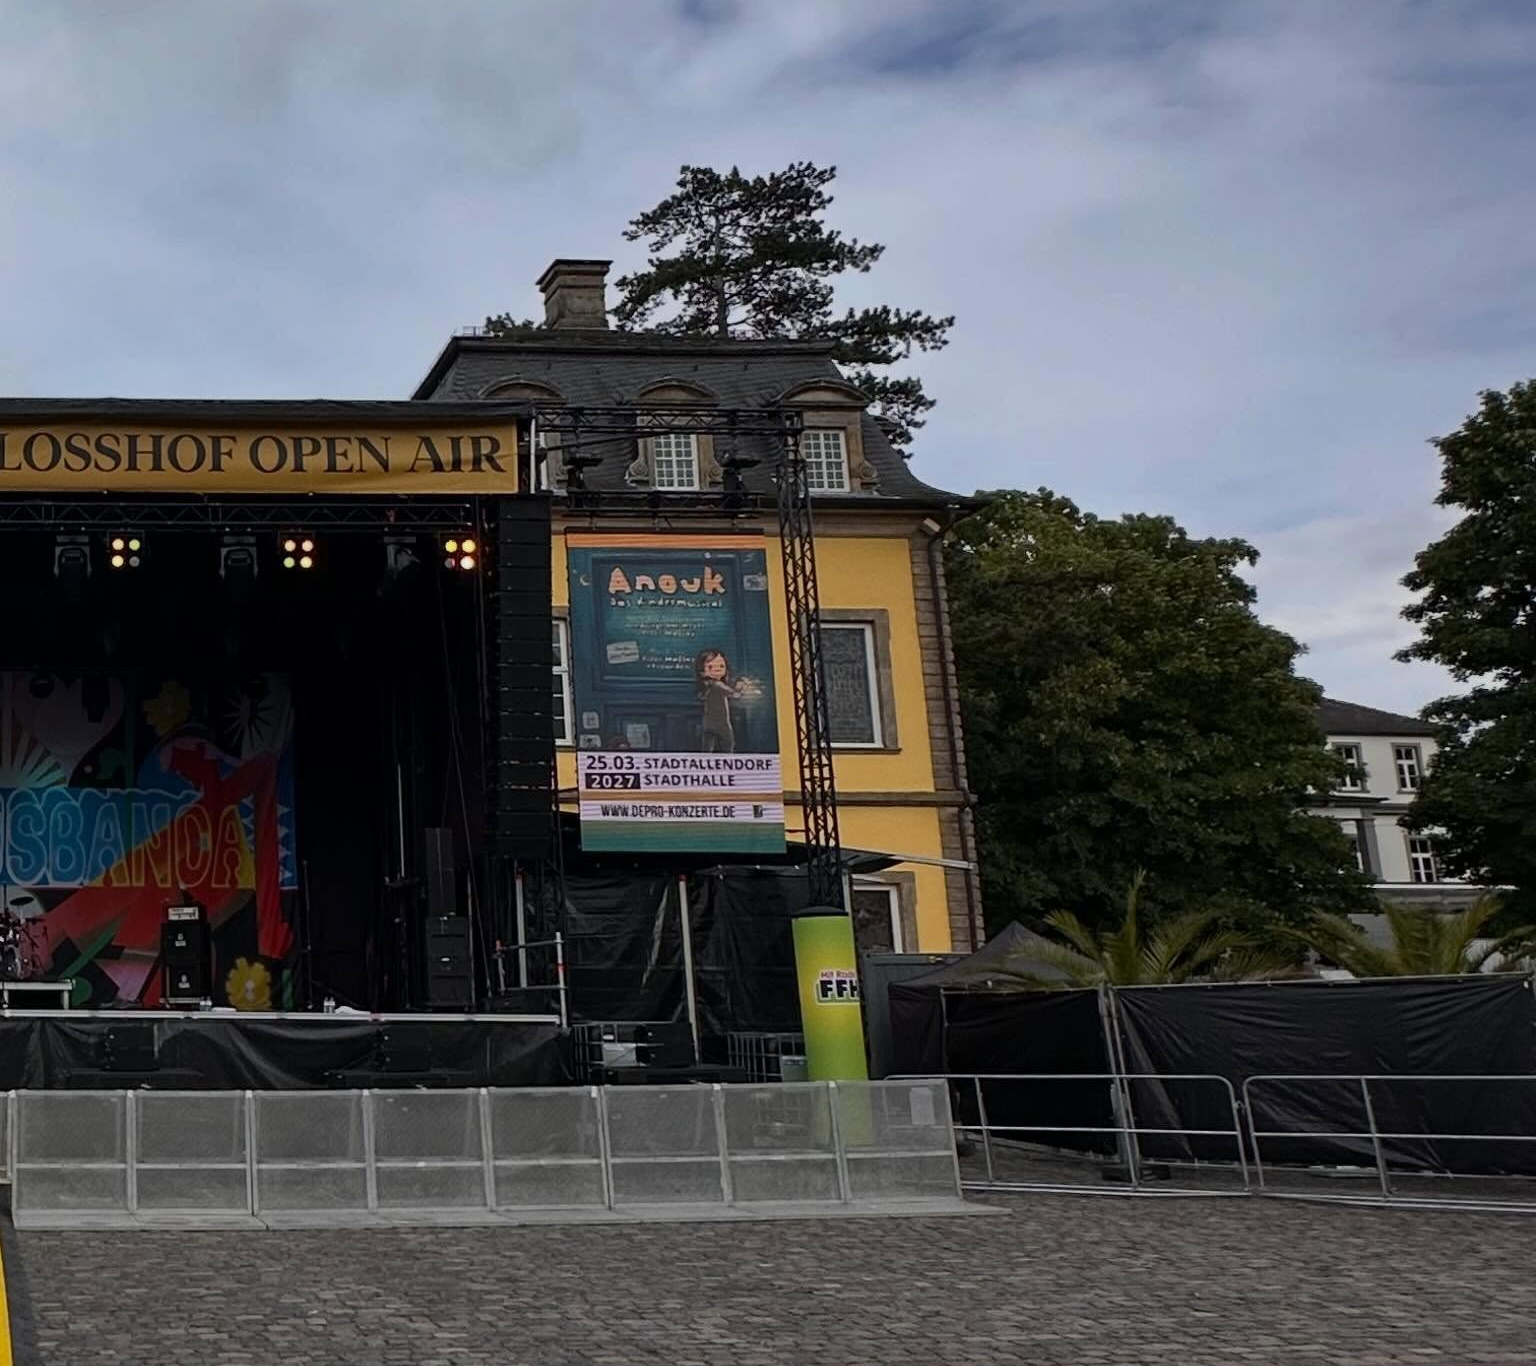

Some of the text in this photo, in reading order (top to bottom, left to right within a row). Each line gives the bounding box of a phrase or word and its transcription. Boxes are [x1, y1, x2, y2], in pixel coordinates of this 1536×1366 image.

[248, 434, 392, 474] OPEN
[409, 435, 508, 474] AIR
[607, 565, 726, 596] Anouk
[585, 755, 773, 771] 25.03. STADTALLENDORF
[591, 773, 736, 789] 2027 STADTHALLE
[600, 803, 736, 819] WWW.DEPRO-KONZERTE.DE
